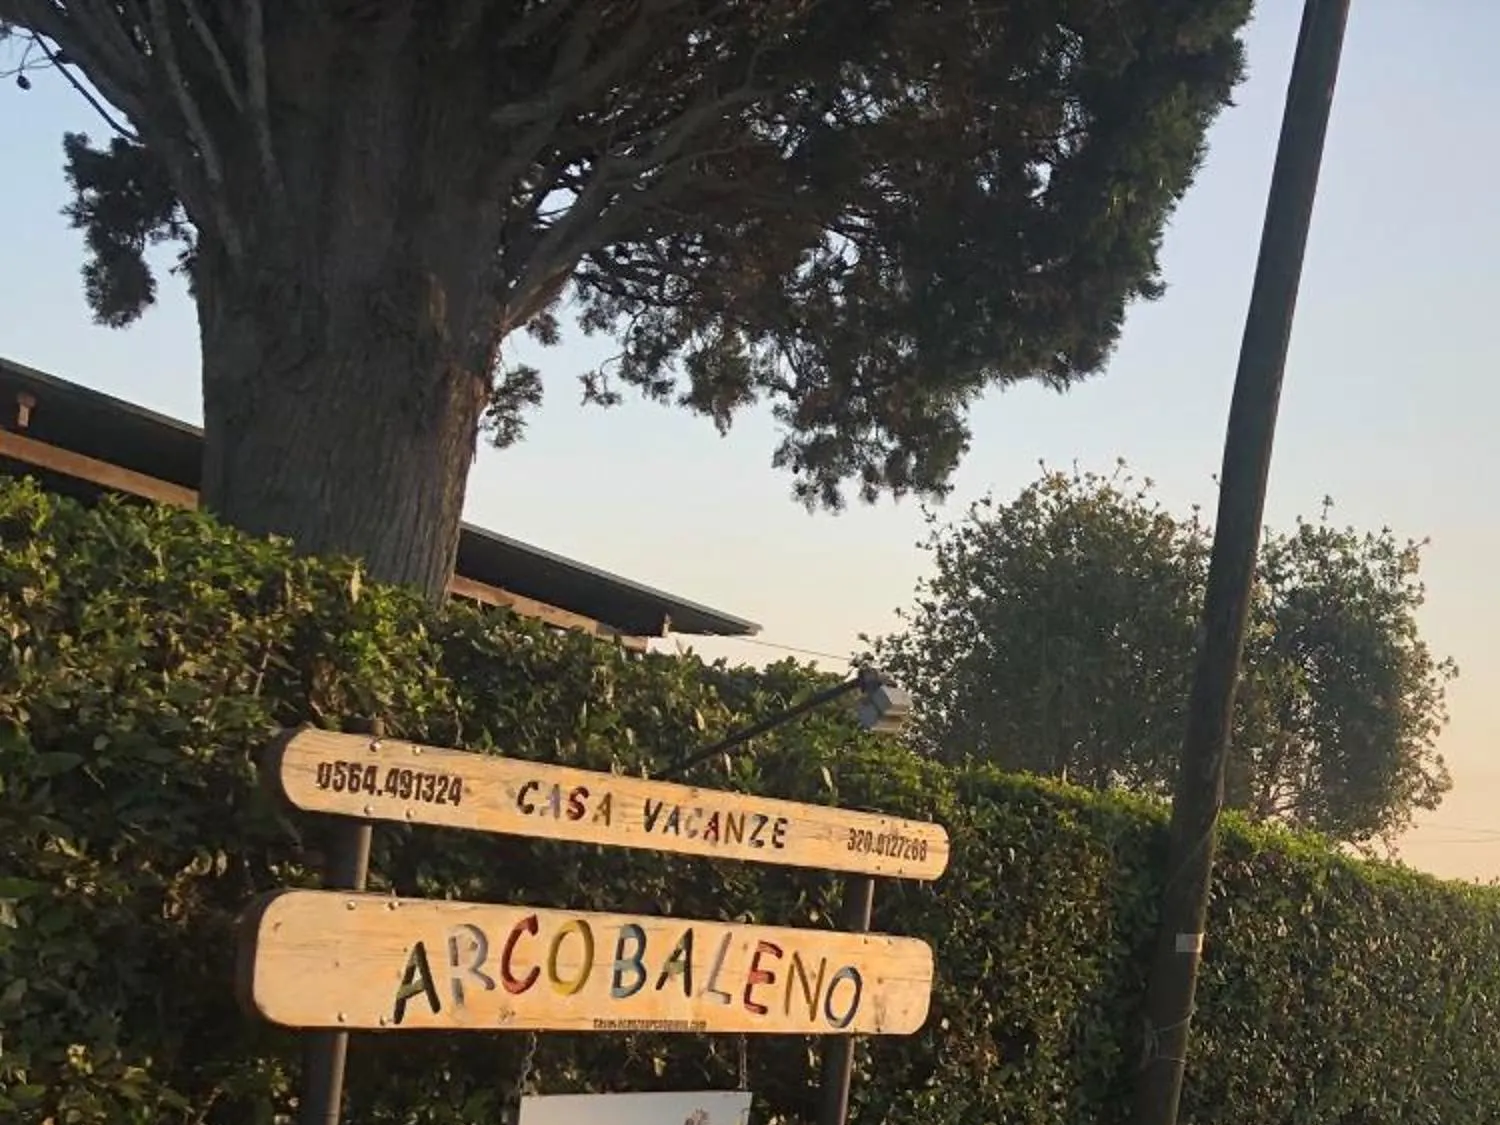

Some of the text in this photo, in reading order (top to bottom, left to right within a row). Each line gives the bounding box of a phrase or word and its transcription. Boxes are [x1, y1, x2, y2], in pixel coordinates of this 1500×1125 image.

[317, 760, 463, 806] 0564.491324
[517, 781, 788, 849] CASA VACANZE
[393, 914, 863, 1029] ARCOBALENO
